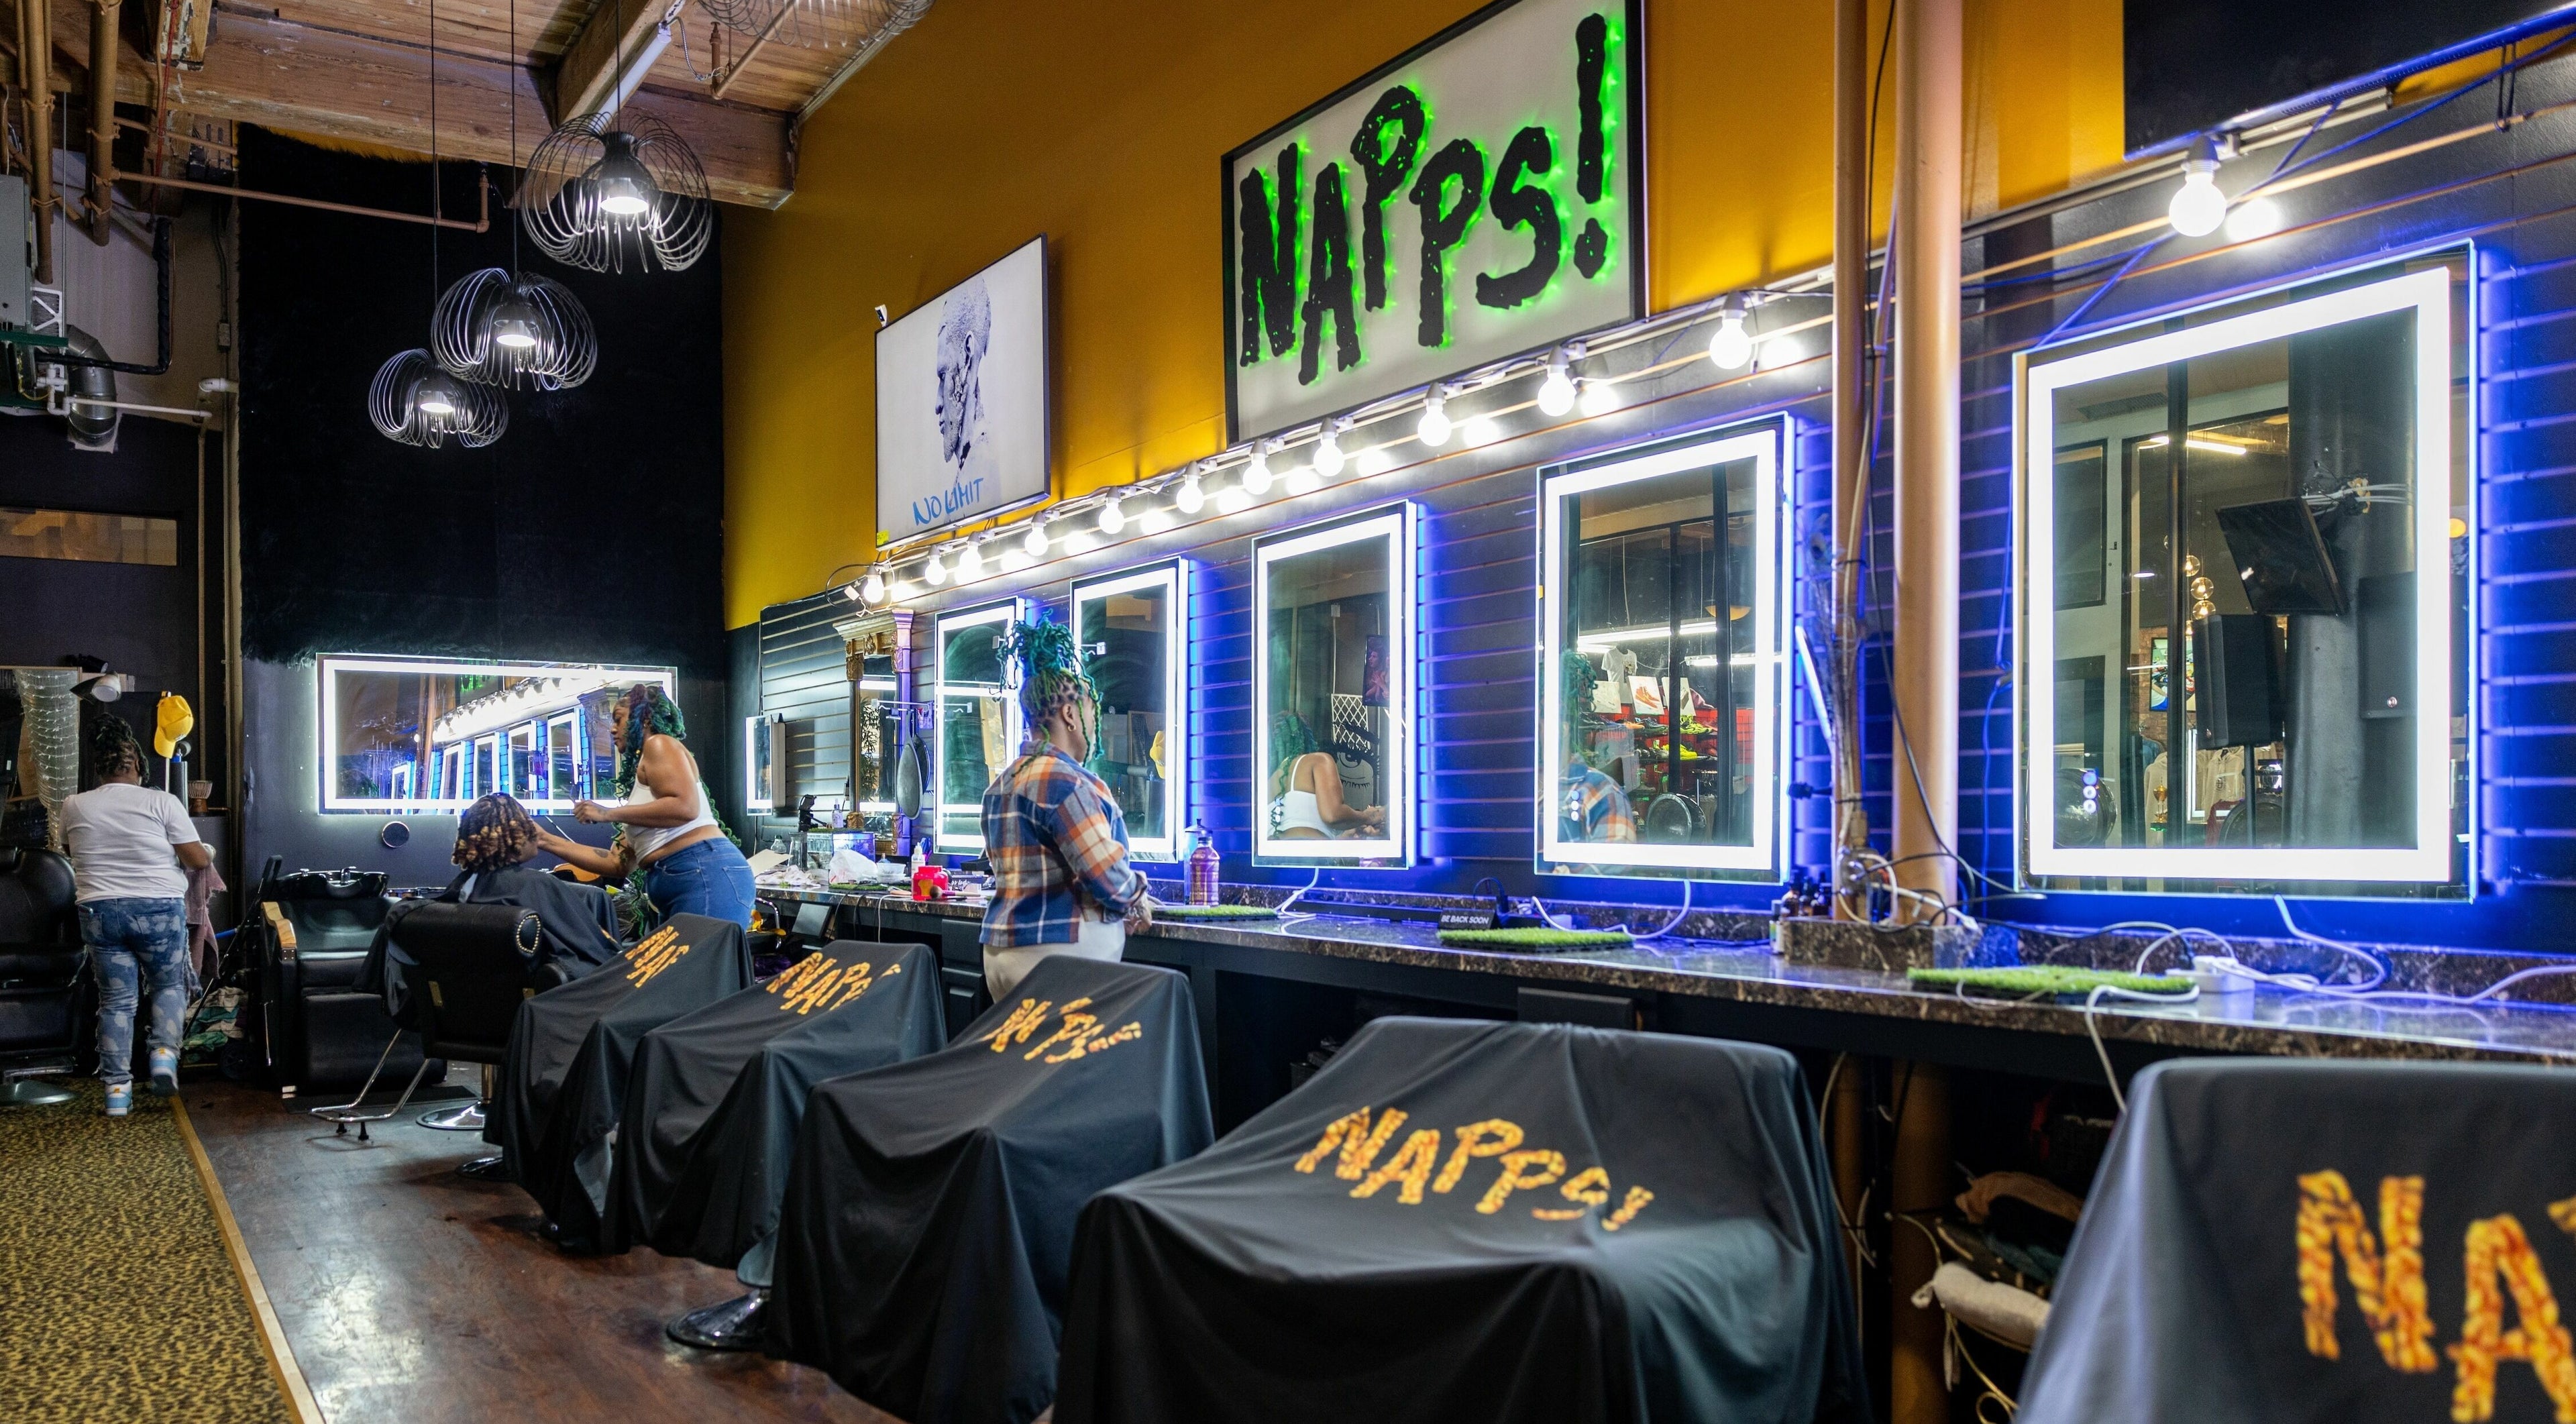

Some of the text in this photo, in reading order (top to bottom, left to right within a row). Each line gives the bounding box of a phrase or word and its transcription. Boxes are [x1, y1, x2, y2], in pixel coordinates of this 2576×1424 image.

[1240, 13, 1608, 386] NAPPS!
[912, 477, 984, 526] NO LIMIT
[1440, 914, 1489, 924] BE BACK SOON
[2296, 1168, 2576, 1424] NA
